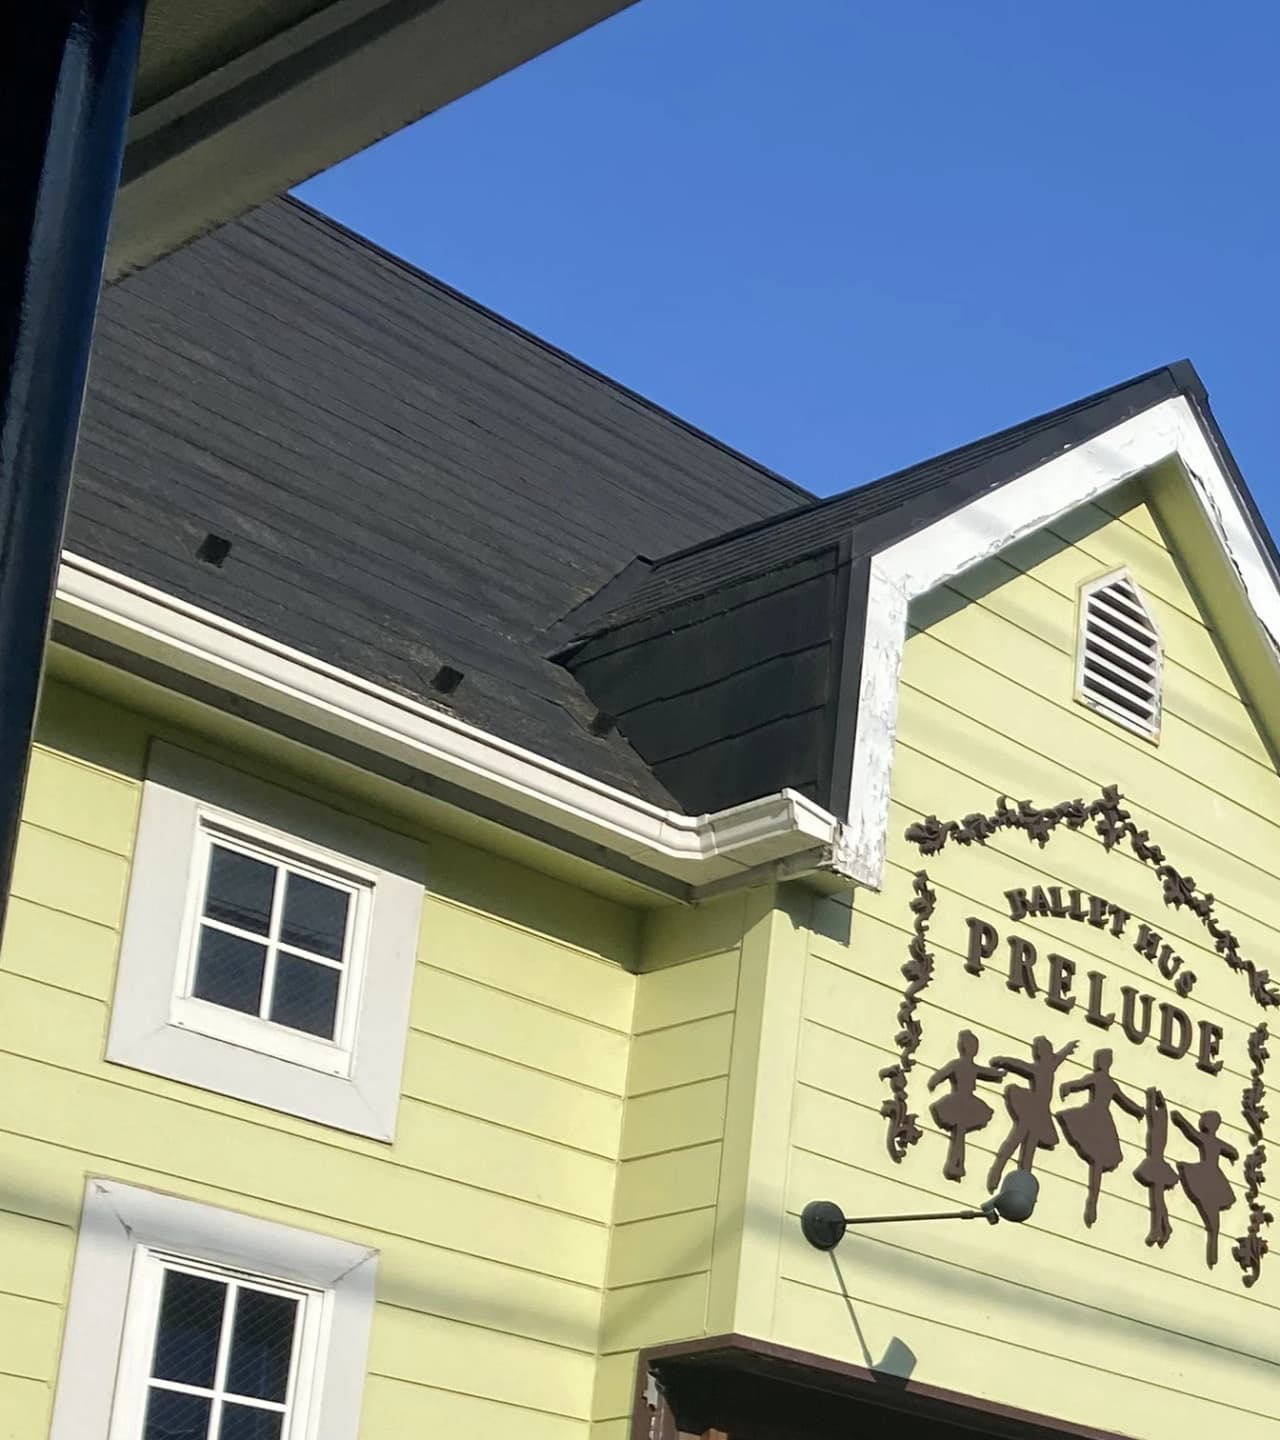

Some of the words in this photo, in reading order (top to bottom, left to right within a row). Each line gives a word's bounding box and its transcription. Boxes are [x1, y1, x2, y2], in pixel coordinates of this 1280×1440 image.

[963, 915, 1225, 1077] PRELUDE
[1003, 885, 1131, 939] BALLET
[1134, 923, 1198, 999] HUS
